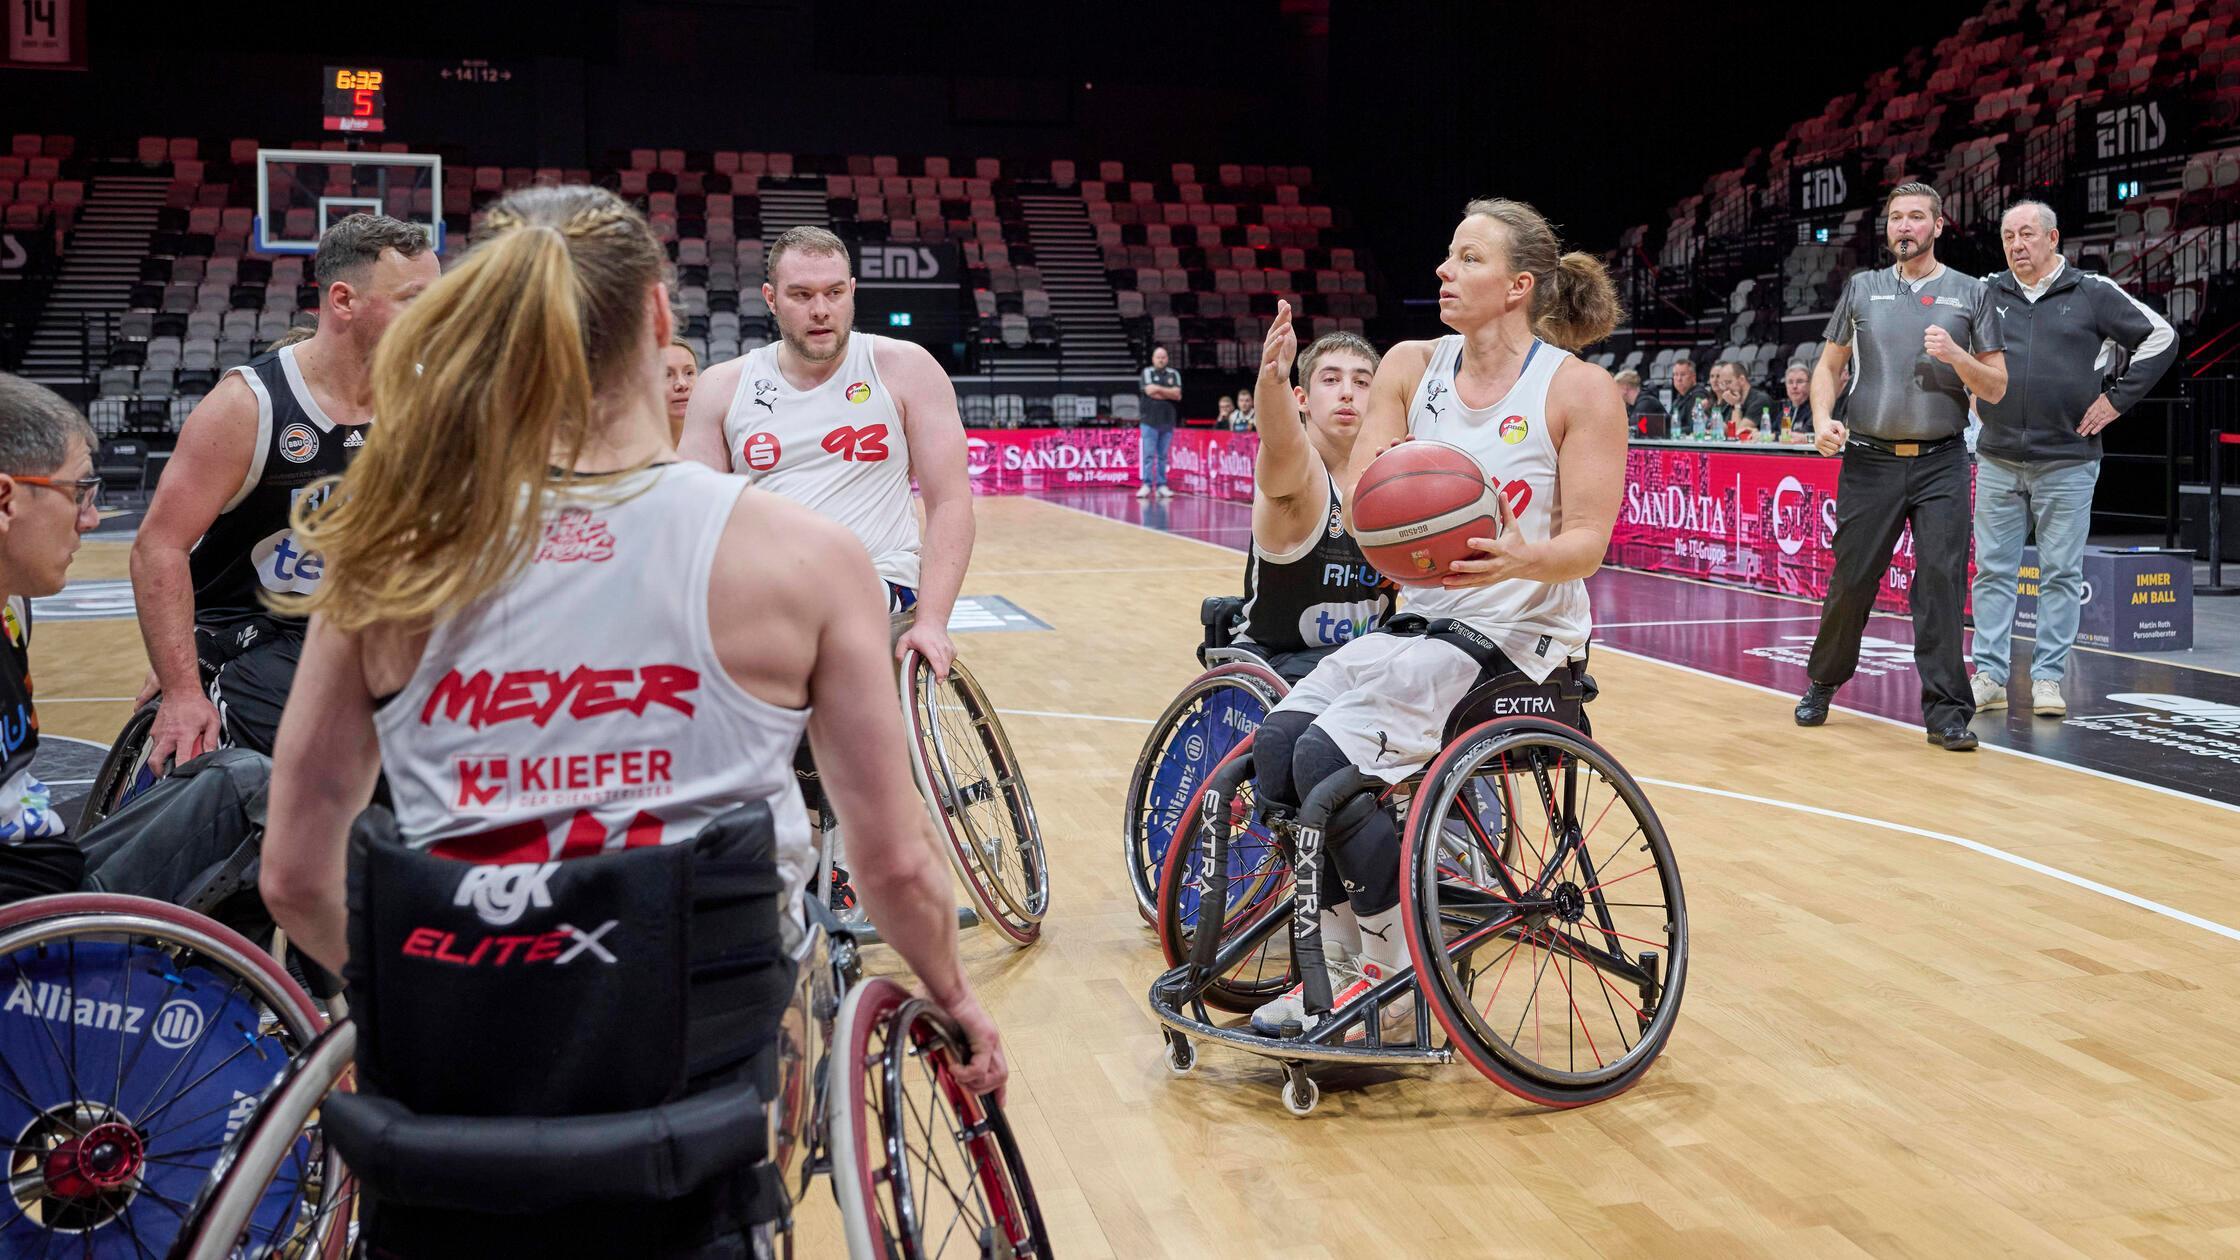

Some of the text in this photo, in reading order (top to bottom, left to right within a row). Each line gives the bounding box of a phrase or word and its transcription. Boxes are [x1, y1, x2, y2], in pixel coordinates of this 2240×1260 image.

[22, 0, 56, 37] 14
[336, 70, 382, 90] 6:32
[456, 68, 498, 82] 14 12
[354, 90, 373, 116] 5
[2097, 101, 2166, 159] EMS
[861, 247, 939, 278] EMS
[821, 423, 889, 462] 93
[1674, 538, 1727, 564] Die IT-Gruppe
[1889, 566, 1907, 589] Die
[2136, 573, 2171, 587] IMMER
[2131, 590, 2176, 605] AM BALL
[2133, 630, 2177, 640] Personalberater
[2139, 621, 2157, 629] Martin
[419, 664, 700, 732] MEYER
[1495, 697, 1556, 714] EXTRA
[1222, 706, 1262, 735] Allian
[519, 749, 673, 791] KIEFER
[1162, 764, 1197, 836] Allianz
[1200, 789, 1220, 898] EXTRA
[1297, 826, 1320, 939] EXTRA
[3, 978, 146, 1034] Allianz
